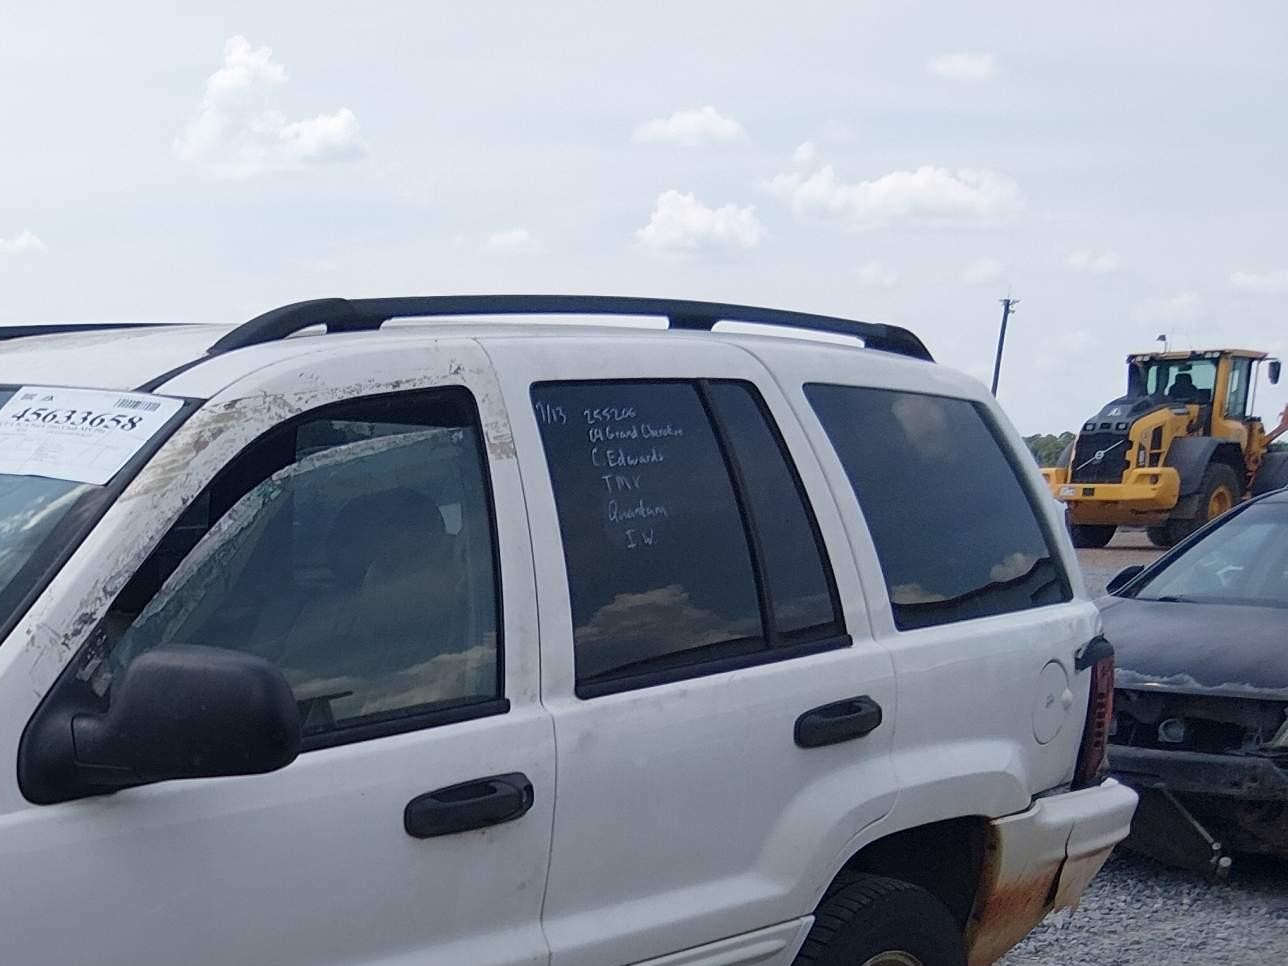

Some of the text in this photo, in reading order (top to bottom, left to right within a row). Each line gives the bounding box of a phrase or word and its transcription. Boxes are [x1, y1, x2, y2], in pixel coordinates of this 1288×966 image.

[12, 407, 143, 431] 45633658
[605, 425, 638, 439] Grand
[607, 448, 664, 467] Edwards
